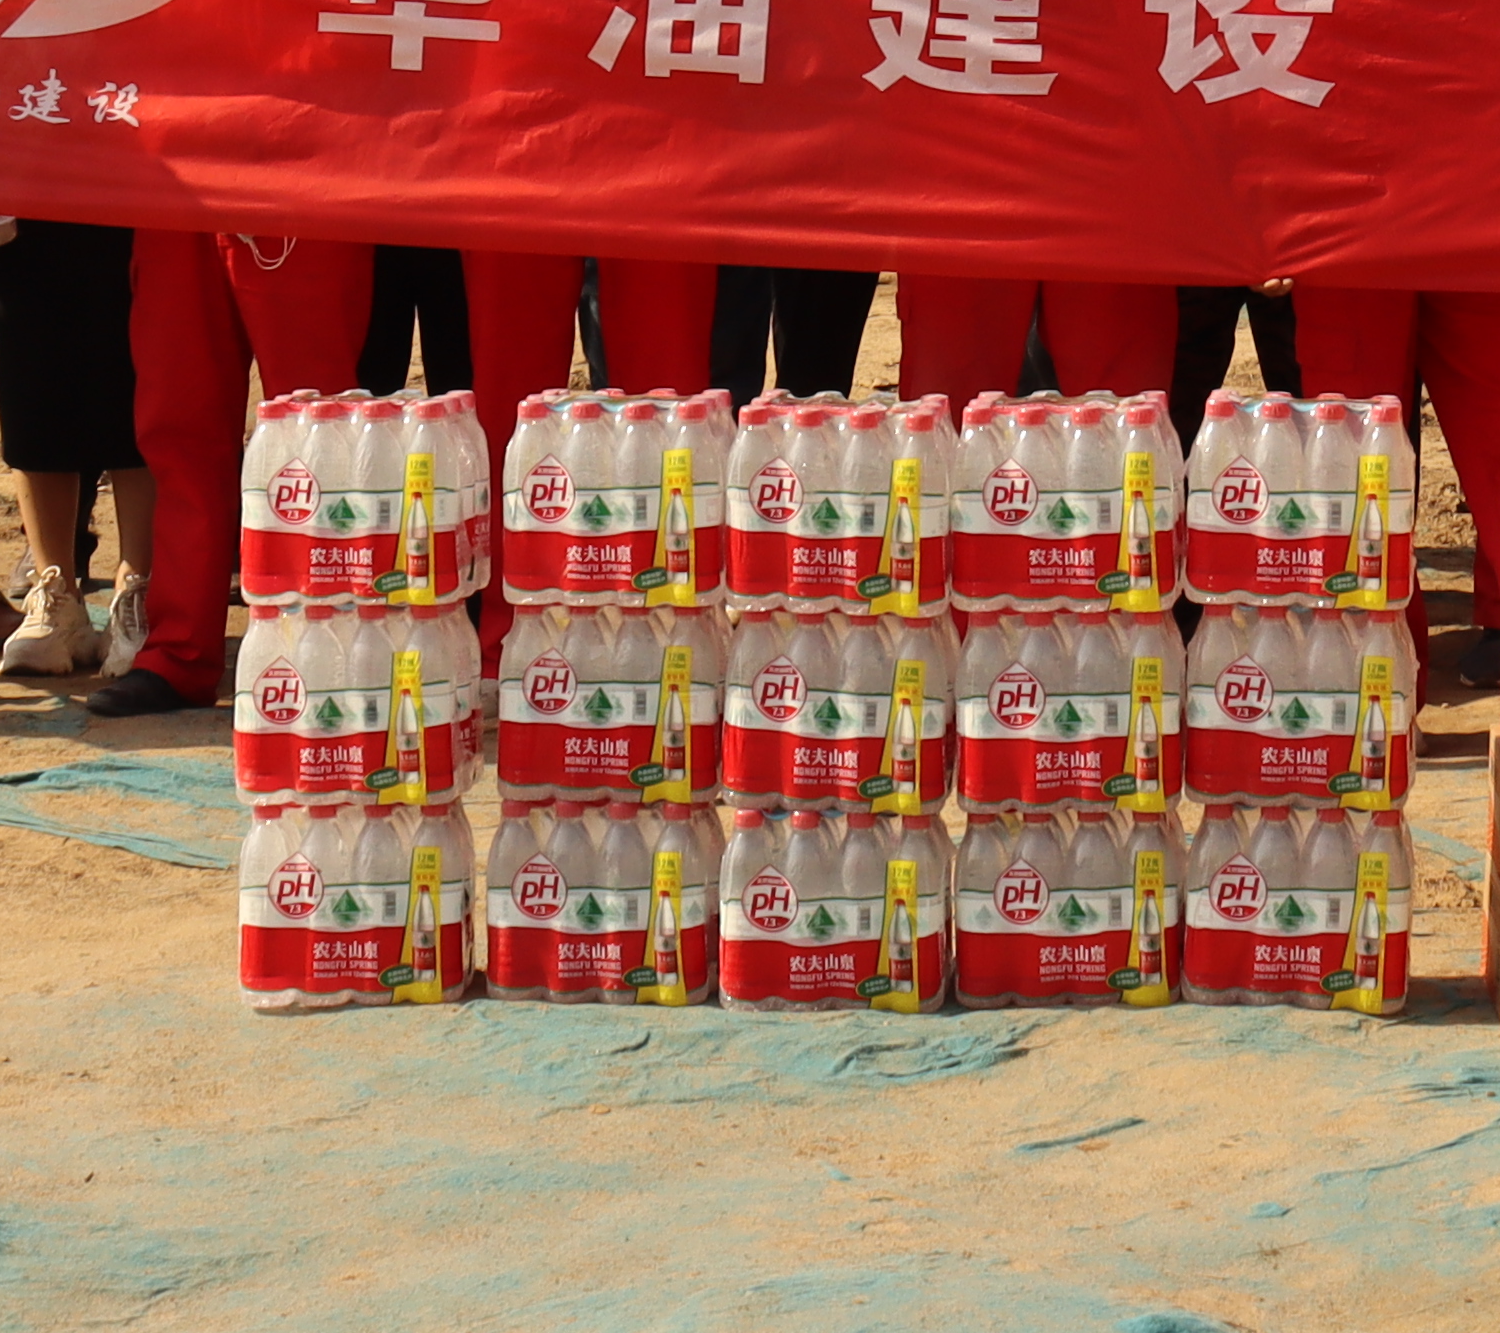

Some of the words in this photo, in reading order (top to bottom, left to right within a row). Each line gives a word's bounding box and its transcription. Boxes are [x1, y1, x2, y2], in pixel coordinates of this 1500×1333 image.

[274, 480, 314, 509] pH
[529, 477, 570, 508] pH
[757, 478, 798, 509] pH
[990, 480, 1031, 511] pH
[1220, 479, 1262, 511] pH
[311, 549, 374, 567] 农夫山泉
[567, 545, 632, 563] 农夫山泉
[794, 549, 857, 567] 农夫山泉
[1030, 549, 1095, 567] 农夫山泉
[1257, 548, 1323, 567] 农夫山泉
[261, 680, 302, 711] pH
[530, 670, 571, 701] pH
[760, 676, 801, 707] pH
[1223, 676, 1266, 708] pH
[996, 683, 1038, 715] pH
[300, 747, 363, 765] 农夫山泉
[566, 739, 629, 757] 农夫山泉
[794, 750, 859, 769] 农夫山泉
[1262, 747, 1328, 766] 农夫山泉
[1036, 752, 1101, 771] 农夫山泉
[276, 874, 317, 905] pH
[520, 875, 561, 906] pH
[1001, 880, 1042, 911] pH
[1217, 876, 1260, 908] pH
[750, 887, 792, 918] pH
[314, 942, 379, 961] 农夫山泉
[559, 944, 621, 961] 农夫山泉
[1041, 946, 1106, 965] 农夫山泉
[1255, 945, 1321, 964] 农夫山泉
[791, 955, 854, 973] 农夫山泉
